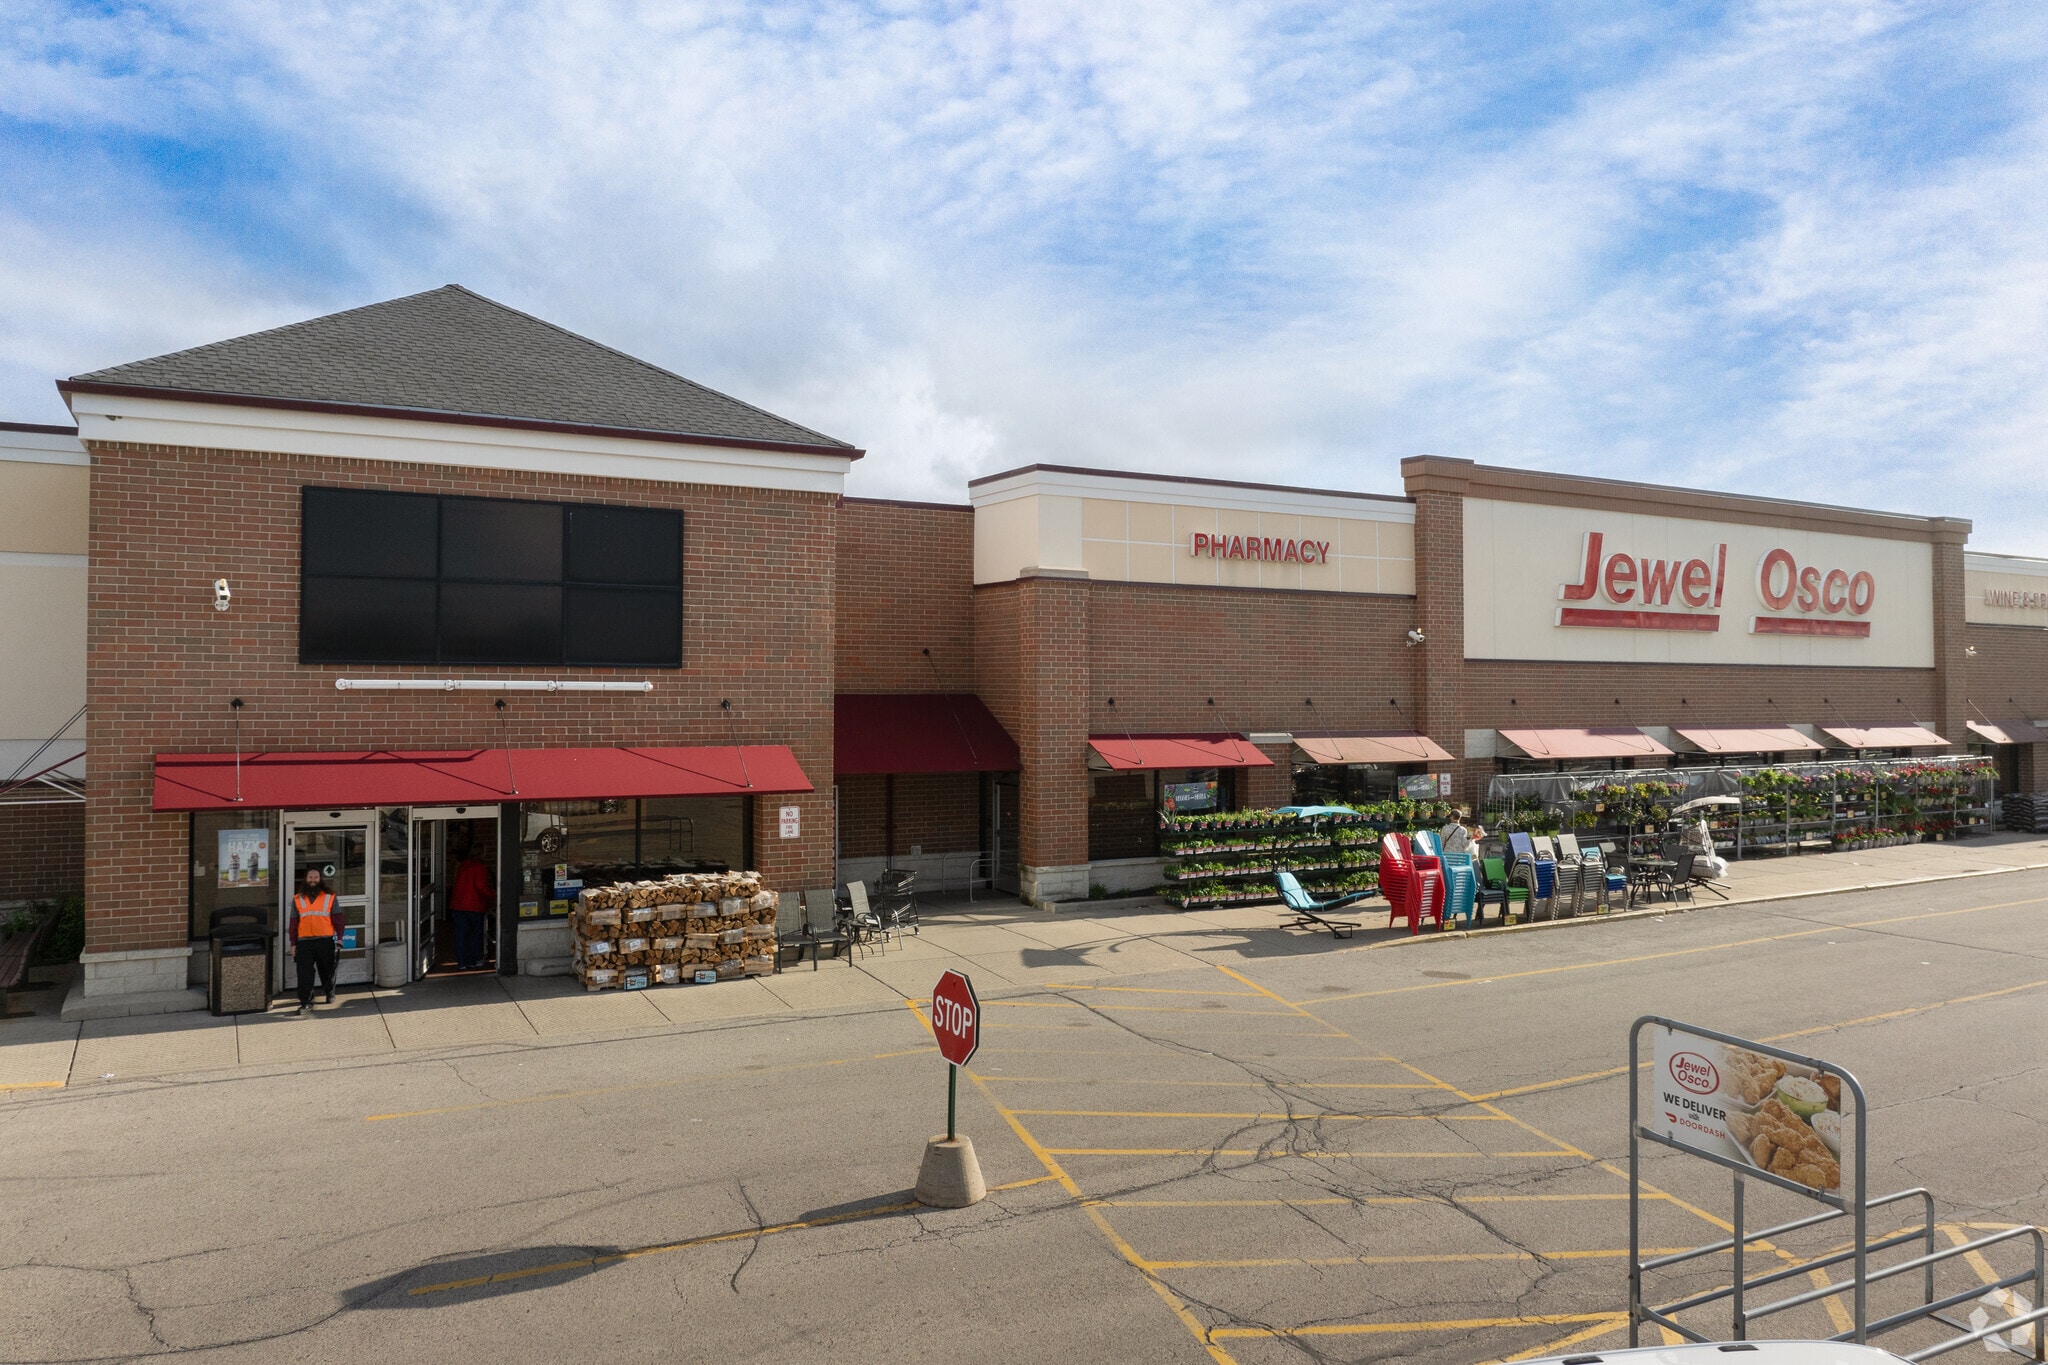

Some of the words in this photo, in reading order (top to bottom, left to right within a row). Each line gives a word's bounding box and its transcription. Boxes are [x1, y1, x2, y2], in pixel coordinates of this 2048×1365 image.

[1191, 532, 1330, 564] PHARMACY
[1559, 532, 1727, 608] Jewel
[1756, 548, 1875, 615] Osco
[1986, 590, 2019, 608] WINE
[2033, 592, 2048, 609] SP
[229, 841, 258, 851] HAZY
[934, 995, 973, 1039] STOP
[1675, 1057, 1711, 1077] Jewel
[1678, 1069, 1709, 1088] Osco
[1663, 1092, 1681, 1107] WE
[1682, 1098, 1727, 1121] DELIVER
[1679, 1118, 1726, 1139] DOORDASH
